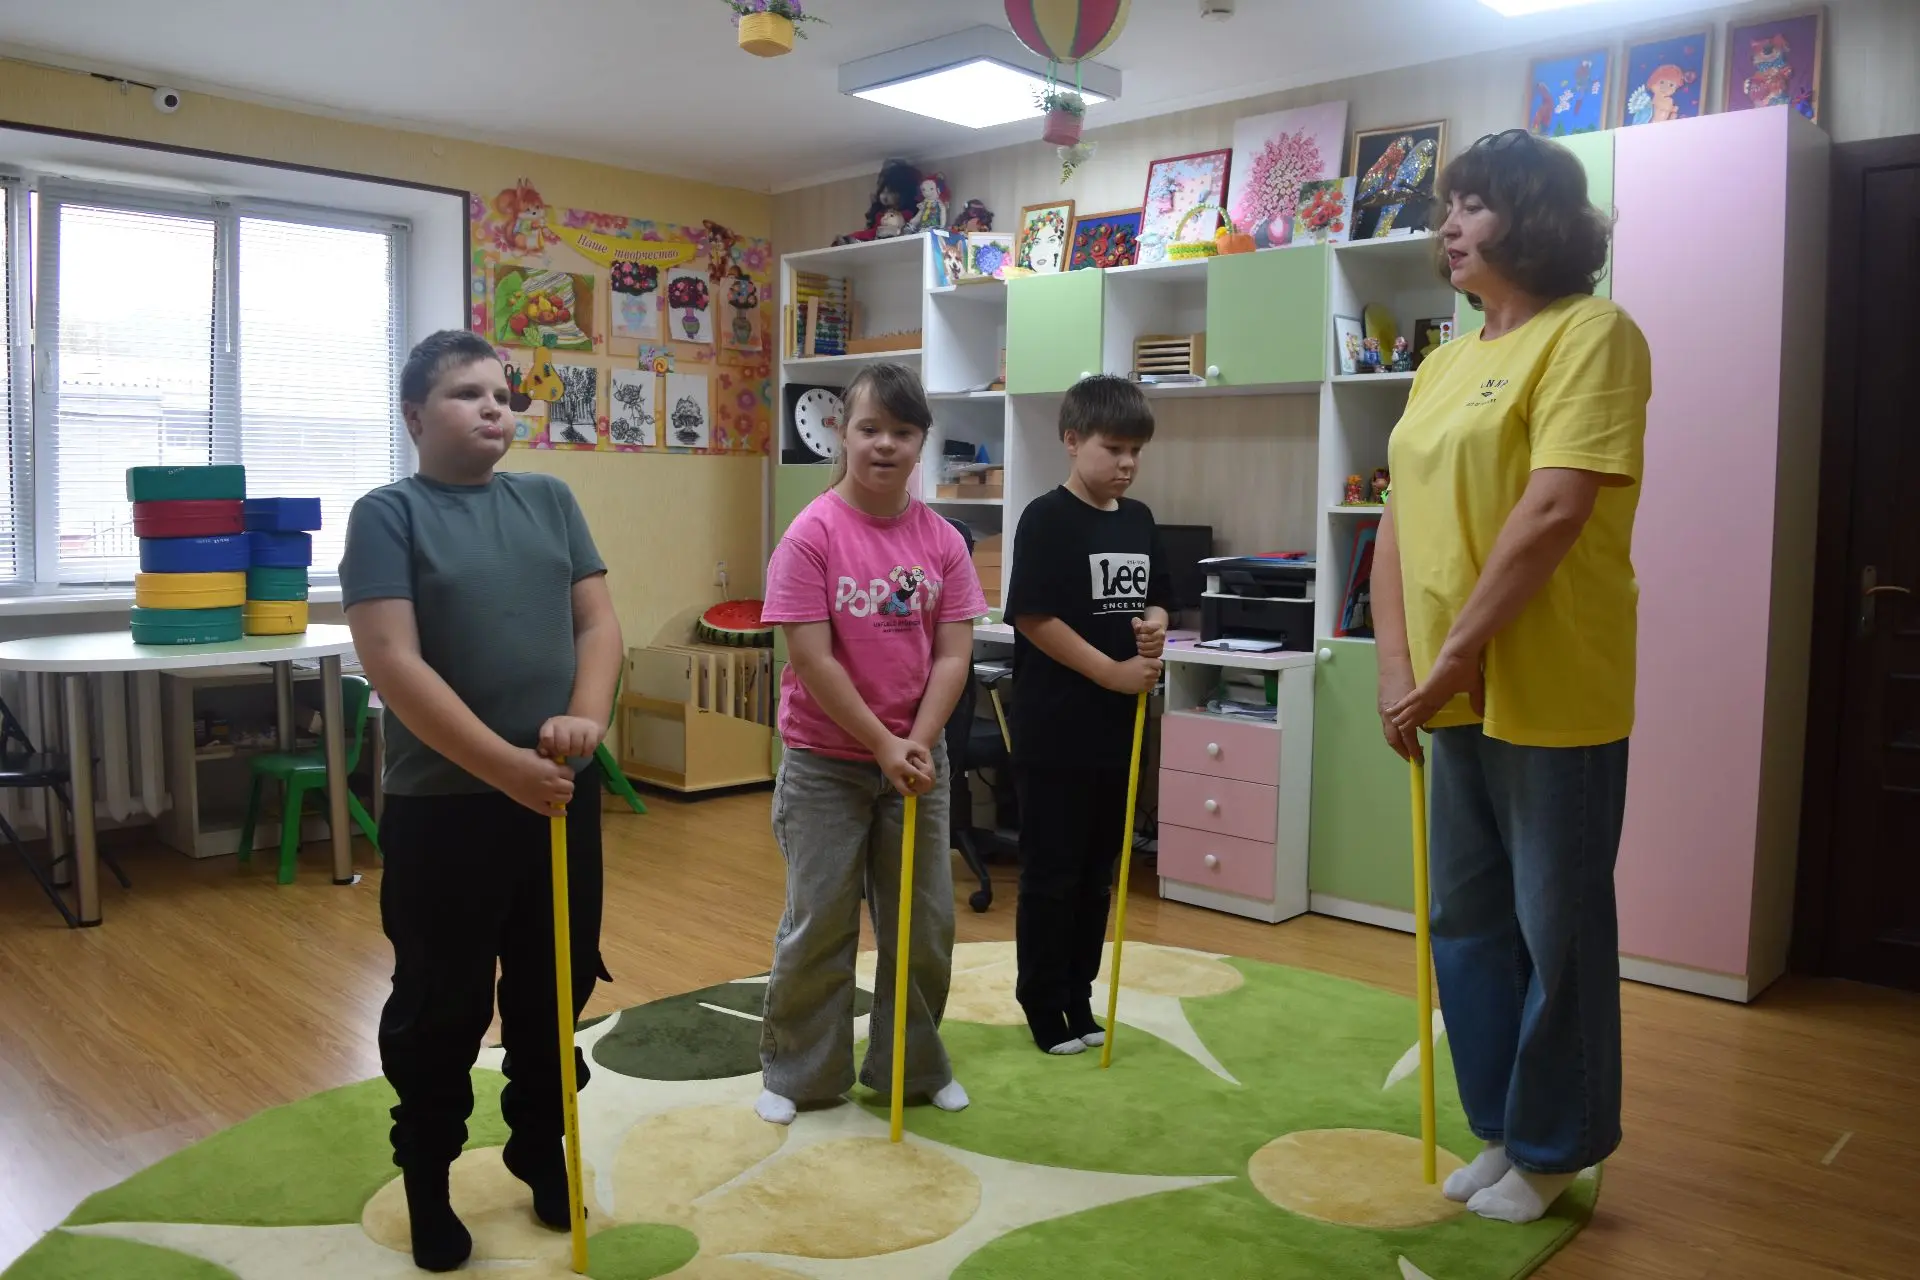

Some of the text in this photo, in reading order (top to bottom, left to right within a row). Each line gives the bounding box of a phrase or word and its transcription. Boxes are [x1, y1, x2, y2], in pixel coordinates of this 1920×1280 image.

[577, 233, 679, 260] Наше творчество
[1099, 559, 1146, 596] Lee
